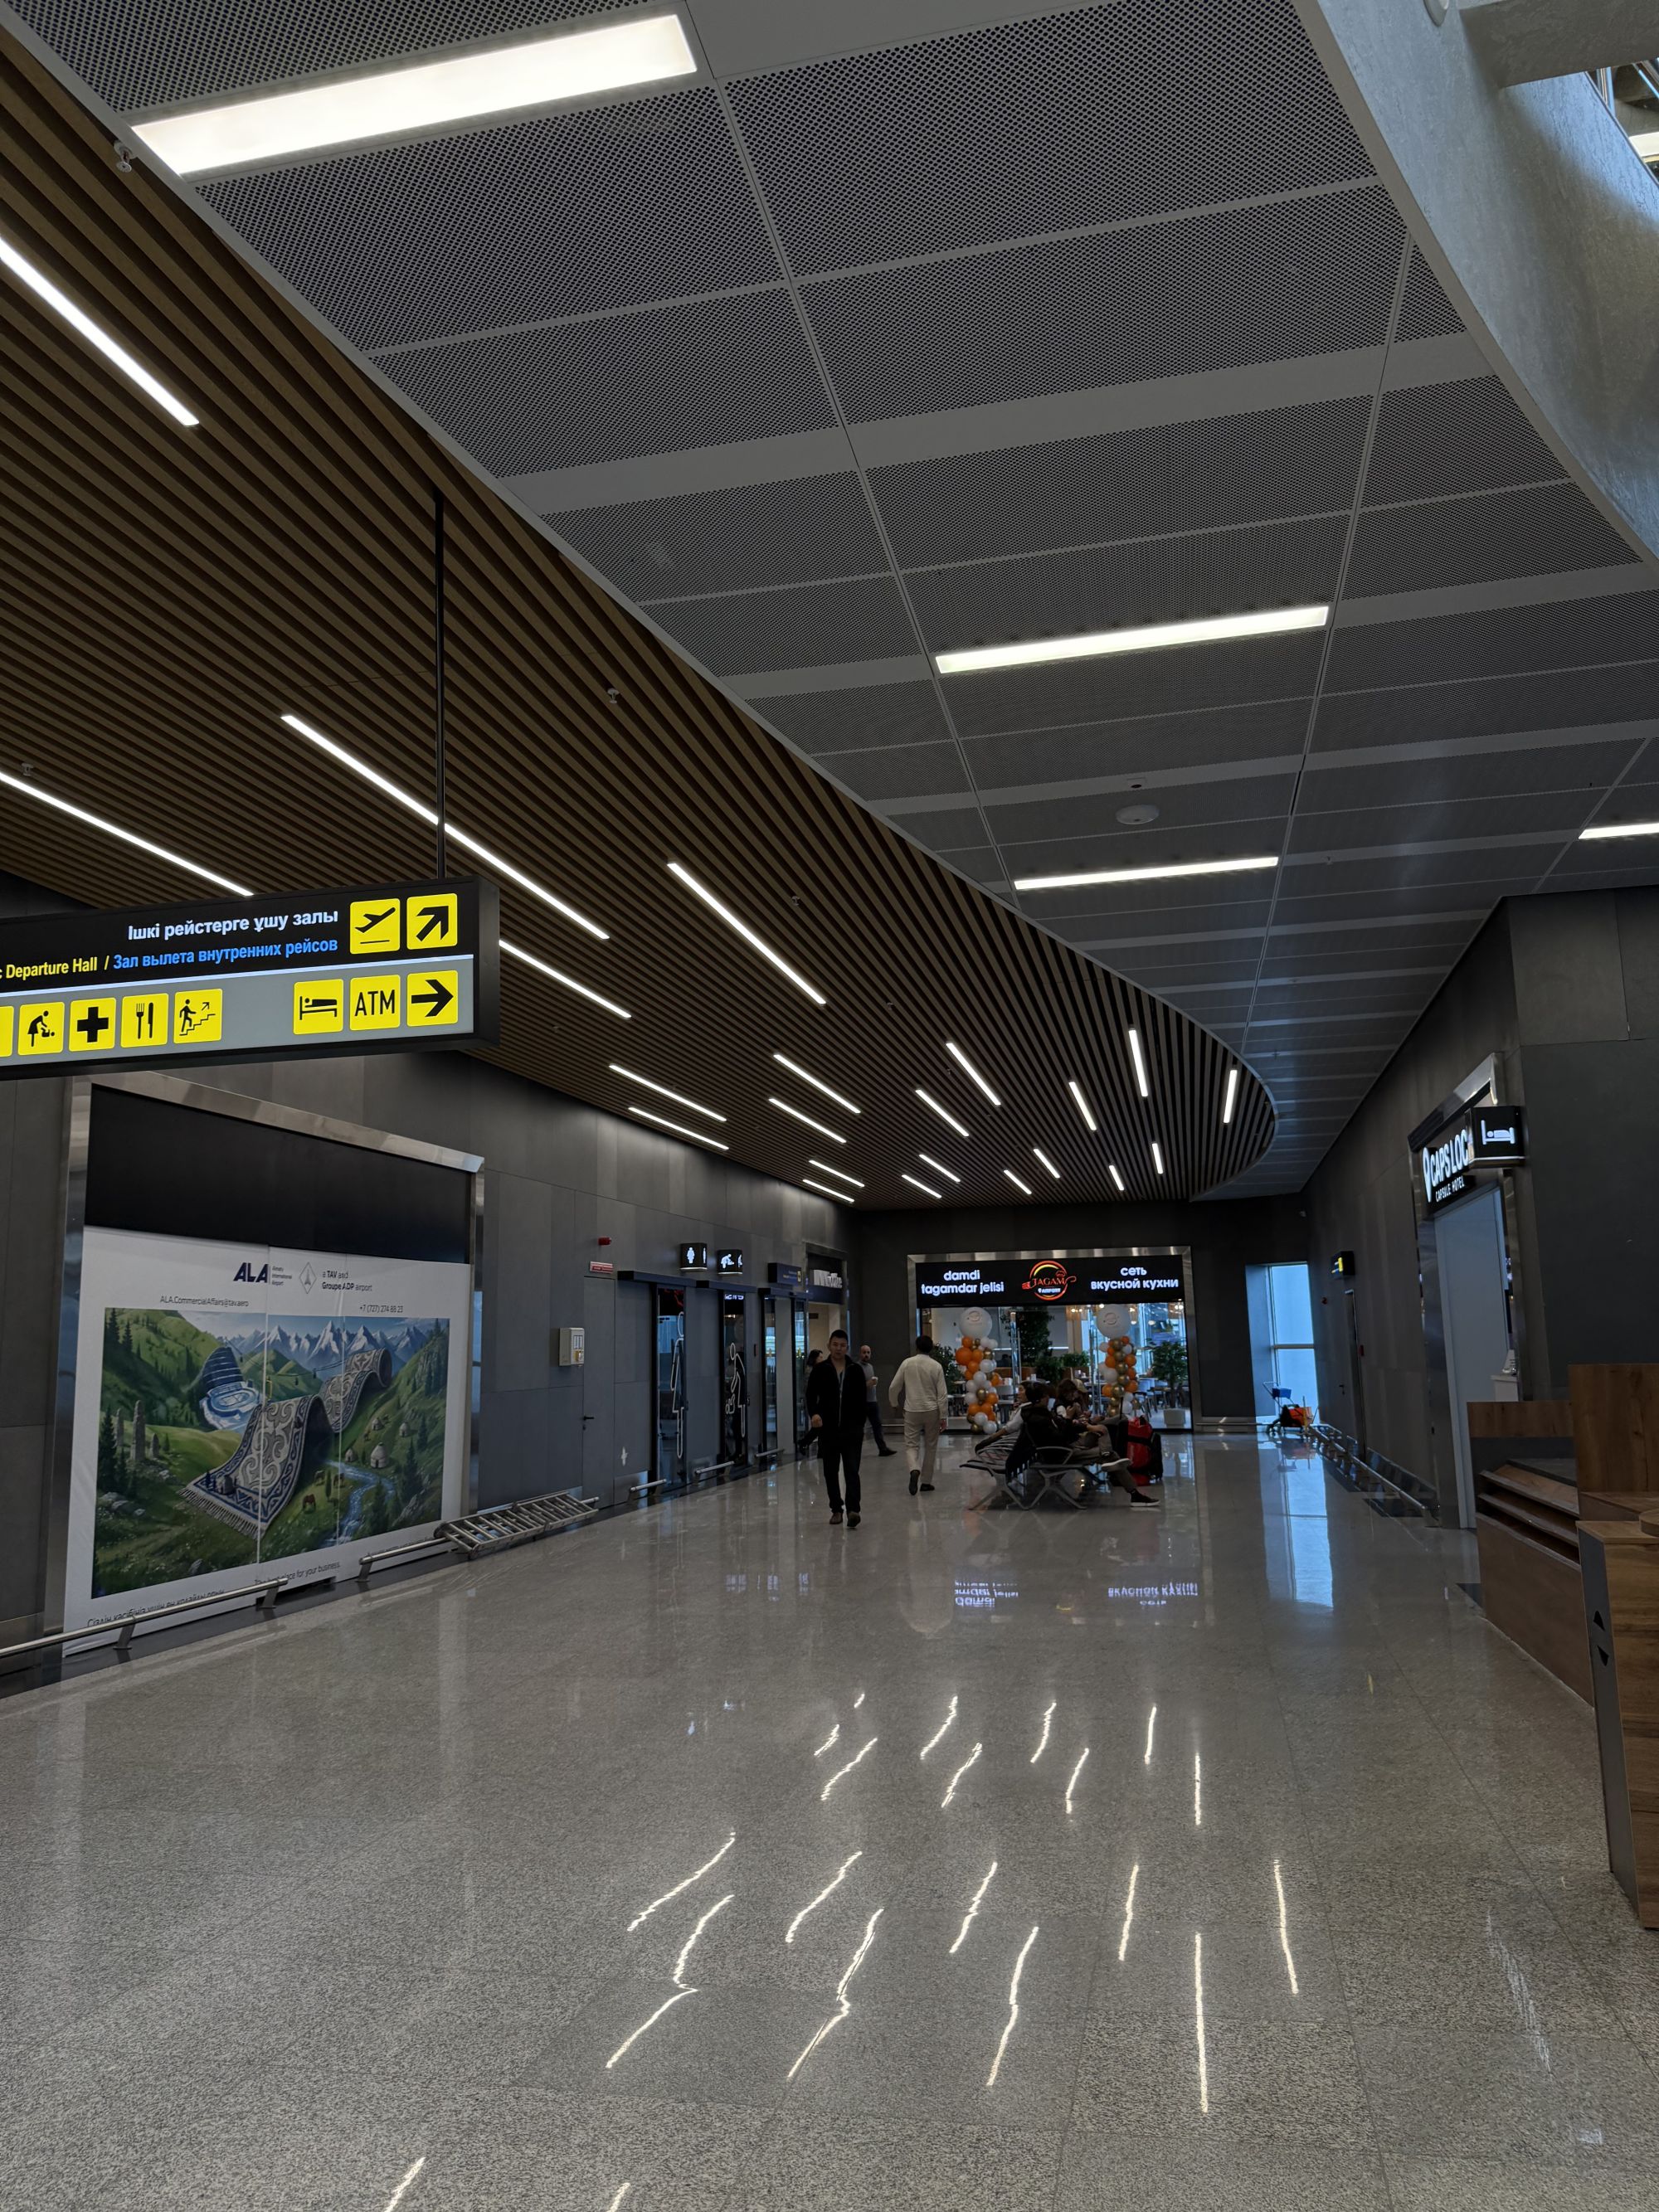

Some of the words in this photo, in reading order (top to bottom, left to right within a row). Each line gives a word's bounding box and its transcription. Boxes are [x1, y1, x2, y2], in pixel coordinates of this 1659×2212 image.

[128, 923, 160, 940] Ішкі
[164, 920, 249, 941] рейстерге
[254, 915, 289, 931] ұшу
[293, 911, 338, 926] залы
[6, 962, 69, 980] Departure
[73, 956, 97, 973] Hall
[113, 954, 139, 969] Зал
[142, 951, 194, 967] вылета
[198, 944, 281, 964] внутренних
[285, 938, 338, 958] рейсов
[354, 989, 395, 1017] ATM
[1452, 1174, 1465, 1193] HOTEL
[233, 1262, 270, 1284] ALA
[943, 1269, 980, 1281] damdi
[1120, 1267, 1147, 1276] сеть
[322, 1281, 341, 1291] Groupe
[921, 1283, 978, 1296] tagamdar
[980, 1281, 1005, 1294] jelisi
[1091, 1278, 1141, 1291] вкусной
[1142, 1279, 1179, 1291] кухни
